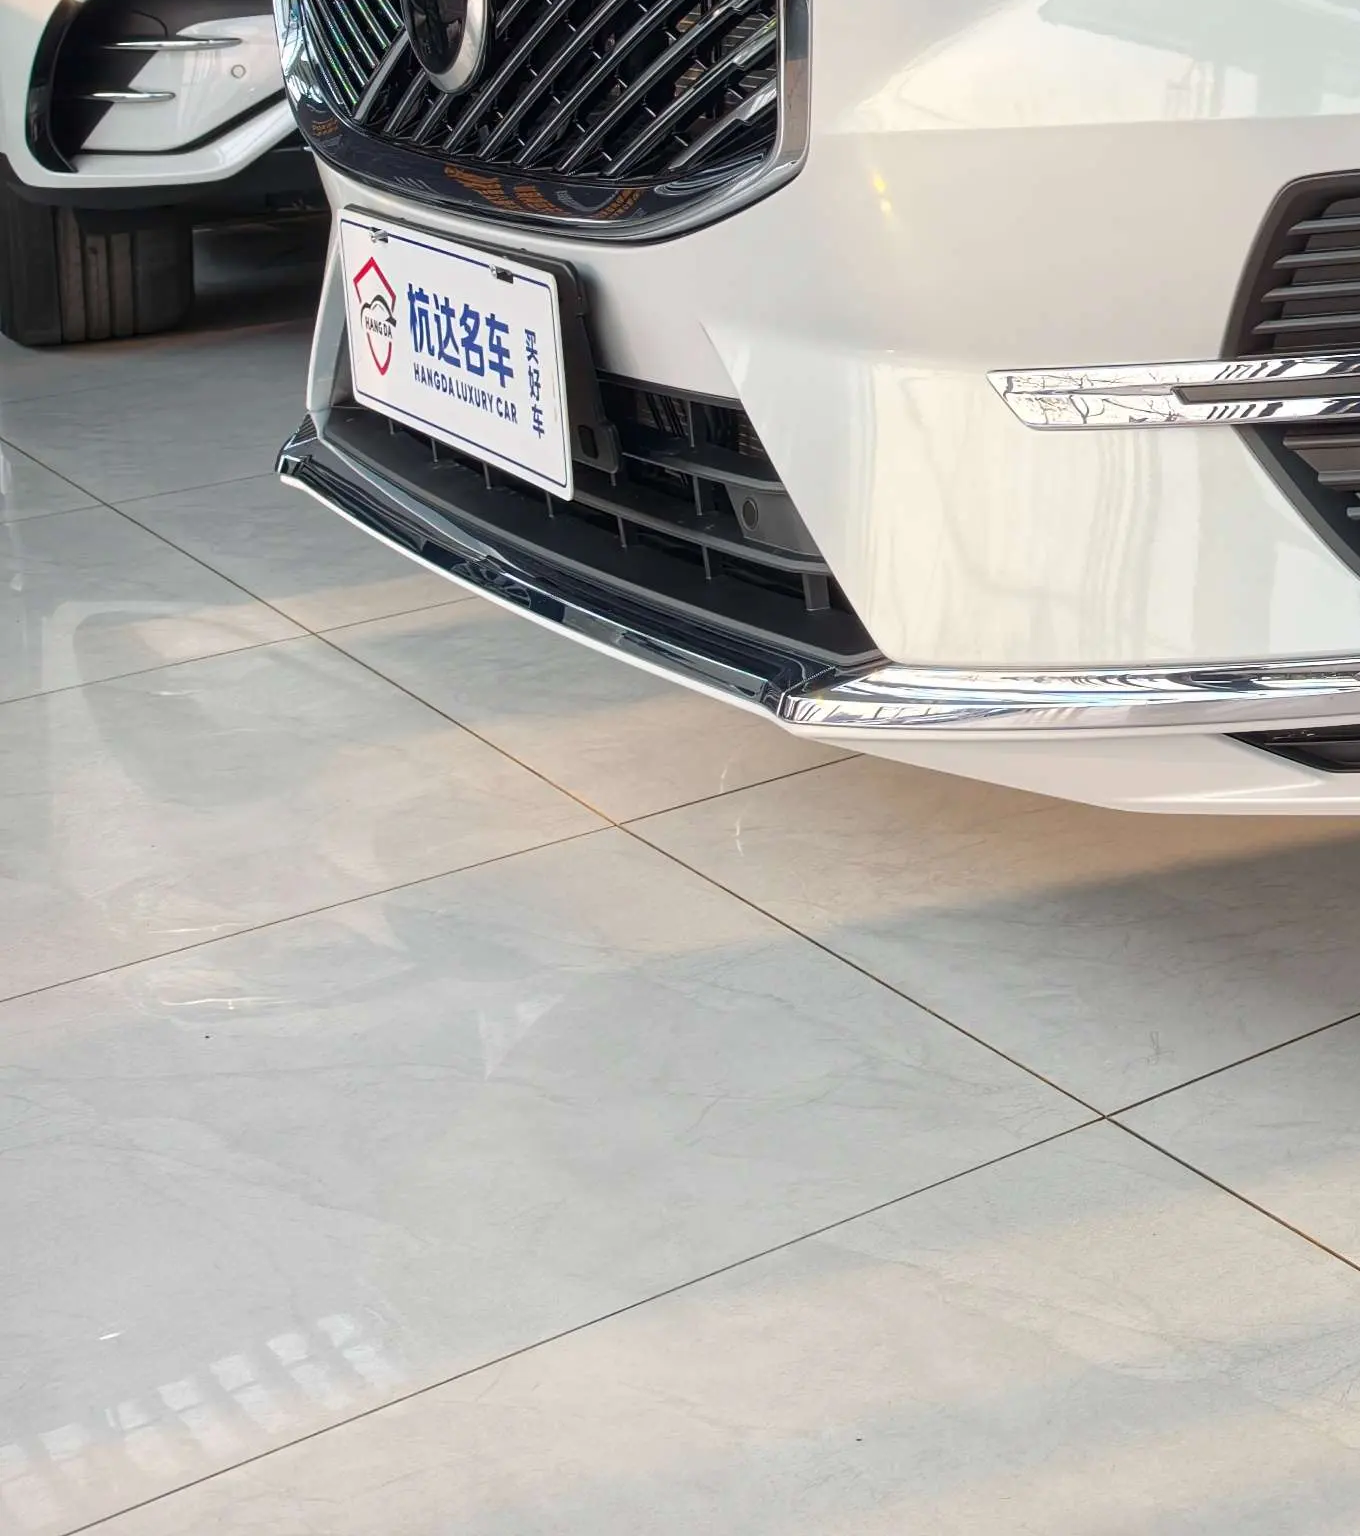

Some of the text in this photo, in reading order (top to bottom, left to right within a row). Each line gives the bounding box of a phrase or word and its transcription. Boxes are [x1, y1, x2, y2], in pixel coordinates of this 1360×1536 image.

[364, 315, 393, 339] HANGDA
[407, 283, 514, 388] 杭达名车
[413, 362, 518, 424] HANGDA LUXURY CAR
[524, 328, 545, 440] 买好车
